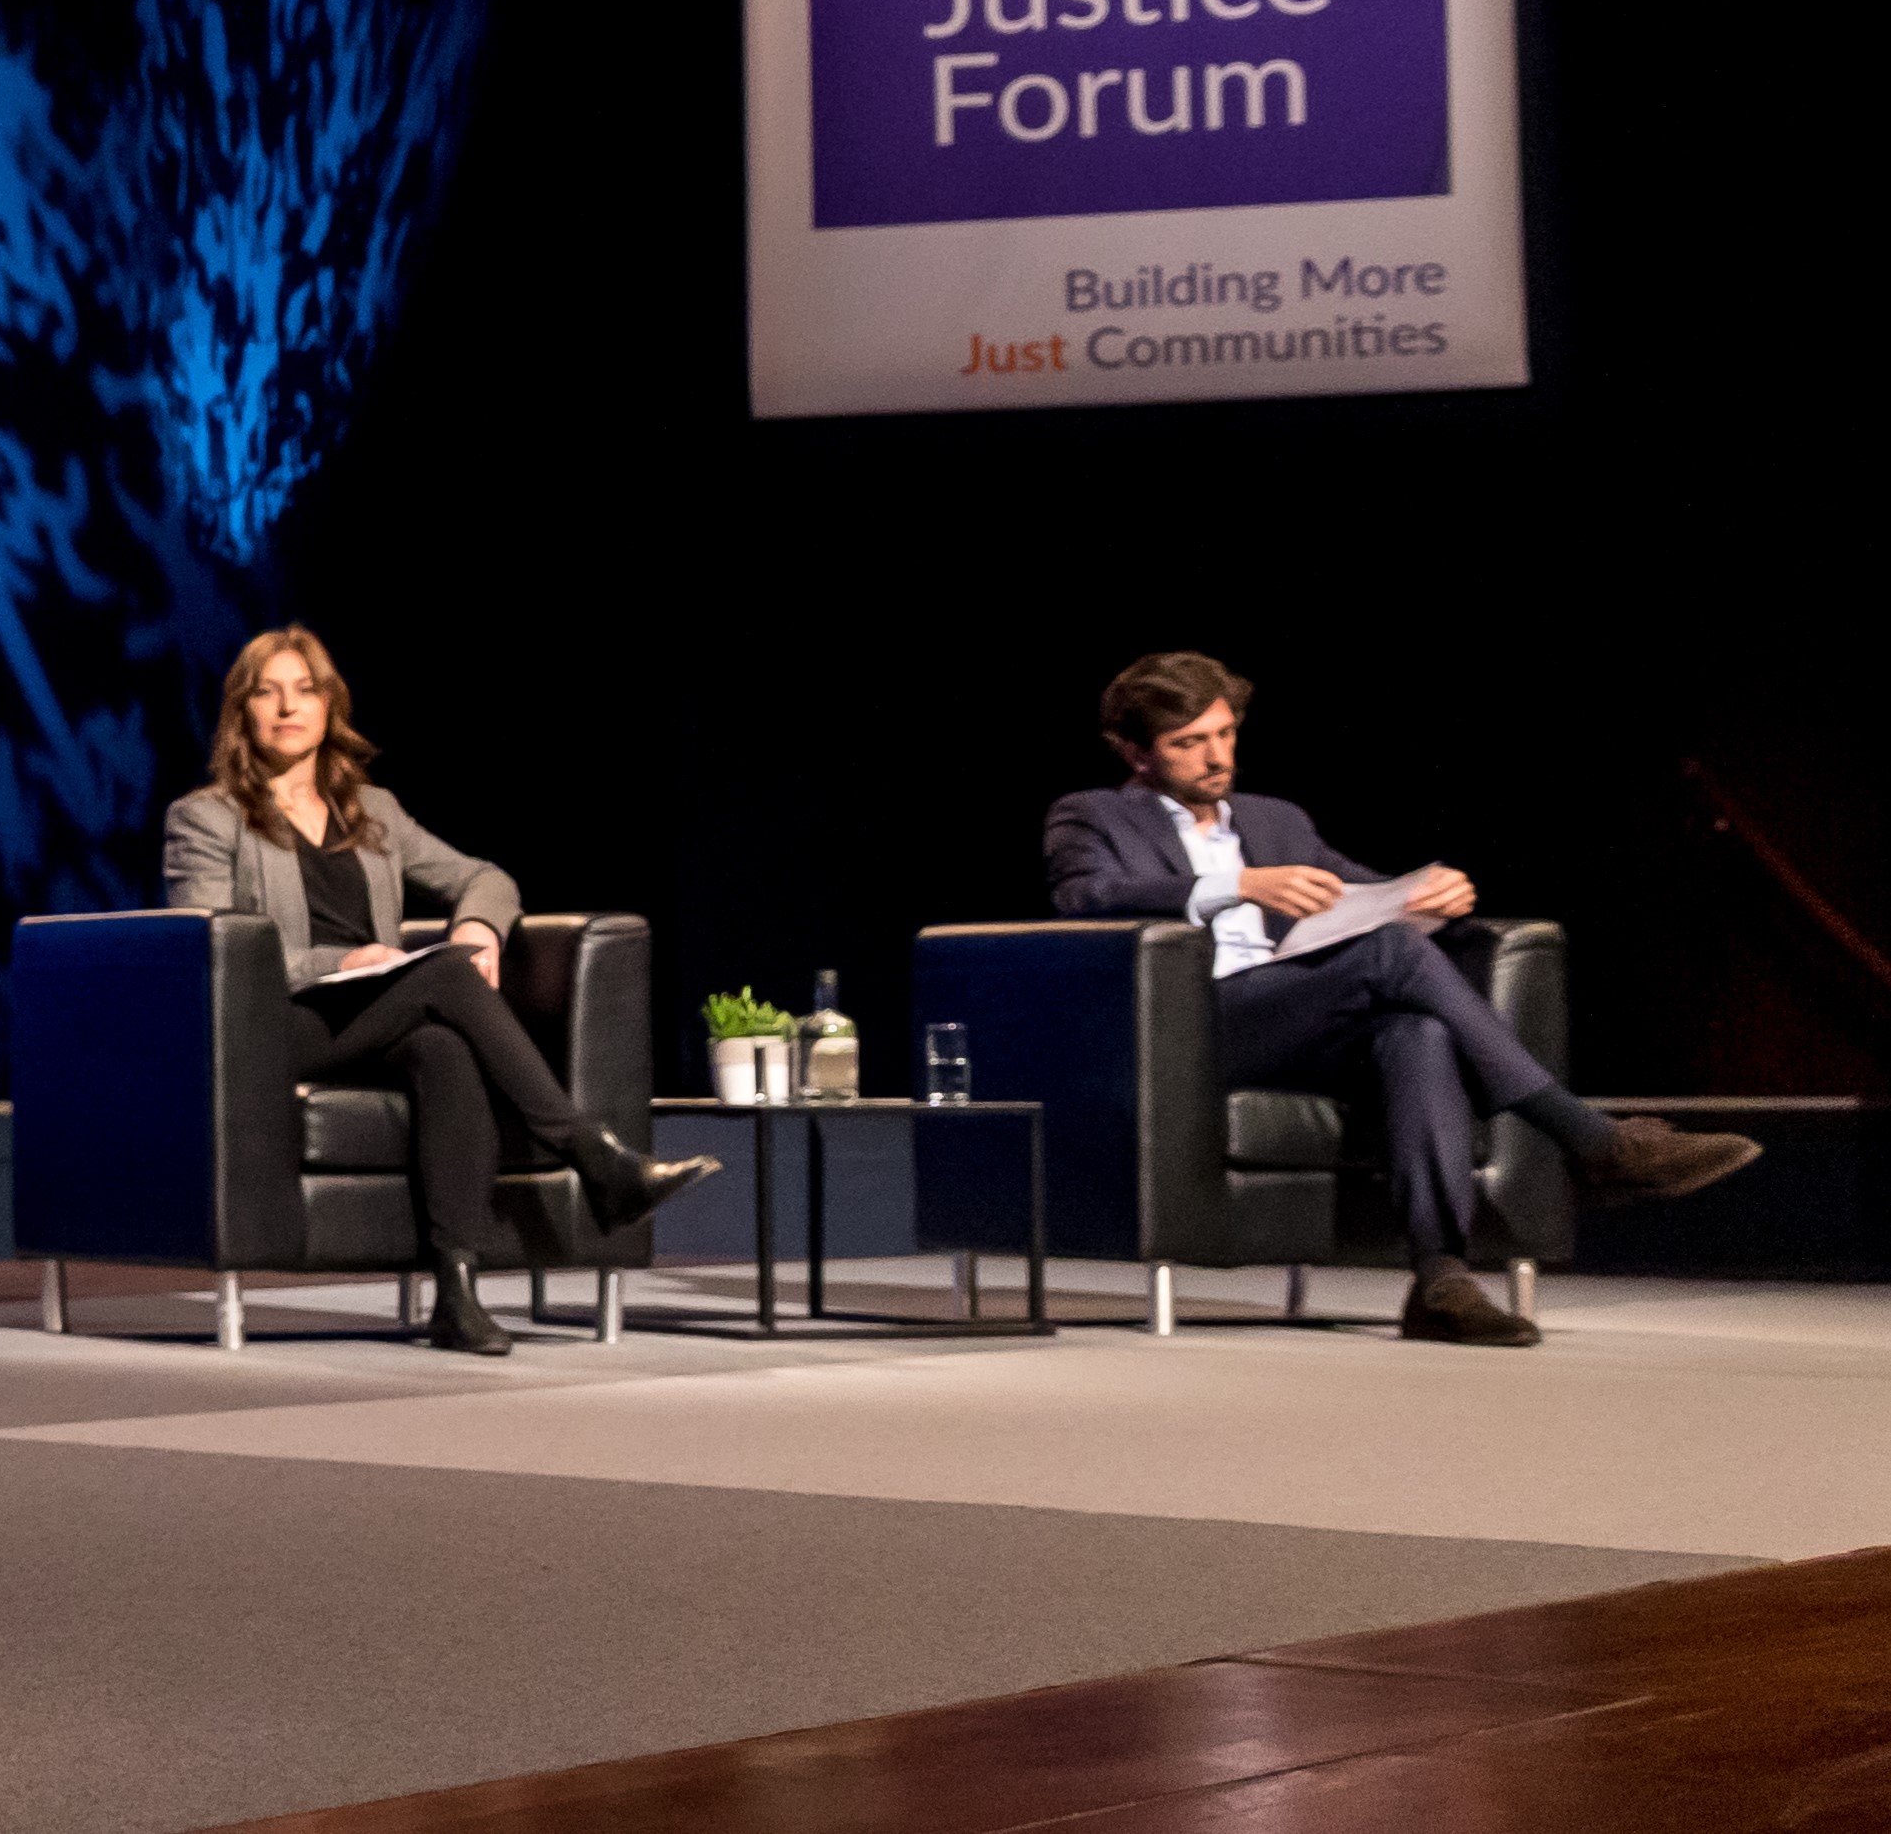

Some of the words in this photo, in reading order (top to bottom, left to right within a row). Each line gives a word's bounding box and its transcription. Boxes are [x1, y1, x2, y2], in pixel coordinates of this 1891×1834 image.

[933, 52, 1307, 147] Forum
[1064, 262, 1282, 313] Building
[1300, 256, 1448, 300] More
[960, 333, 1066, 375] Just
[1086, 314, 1448, 370] Communities
